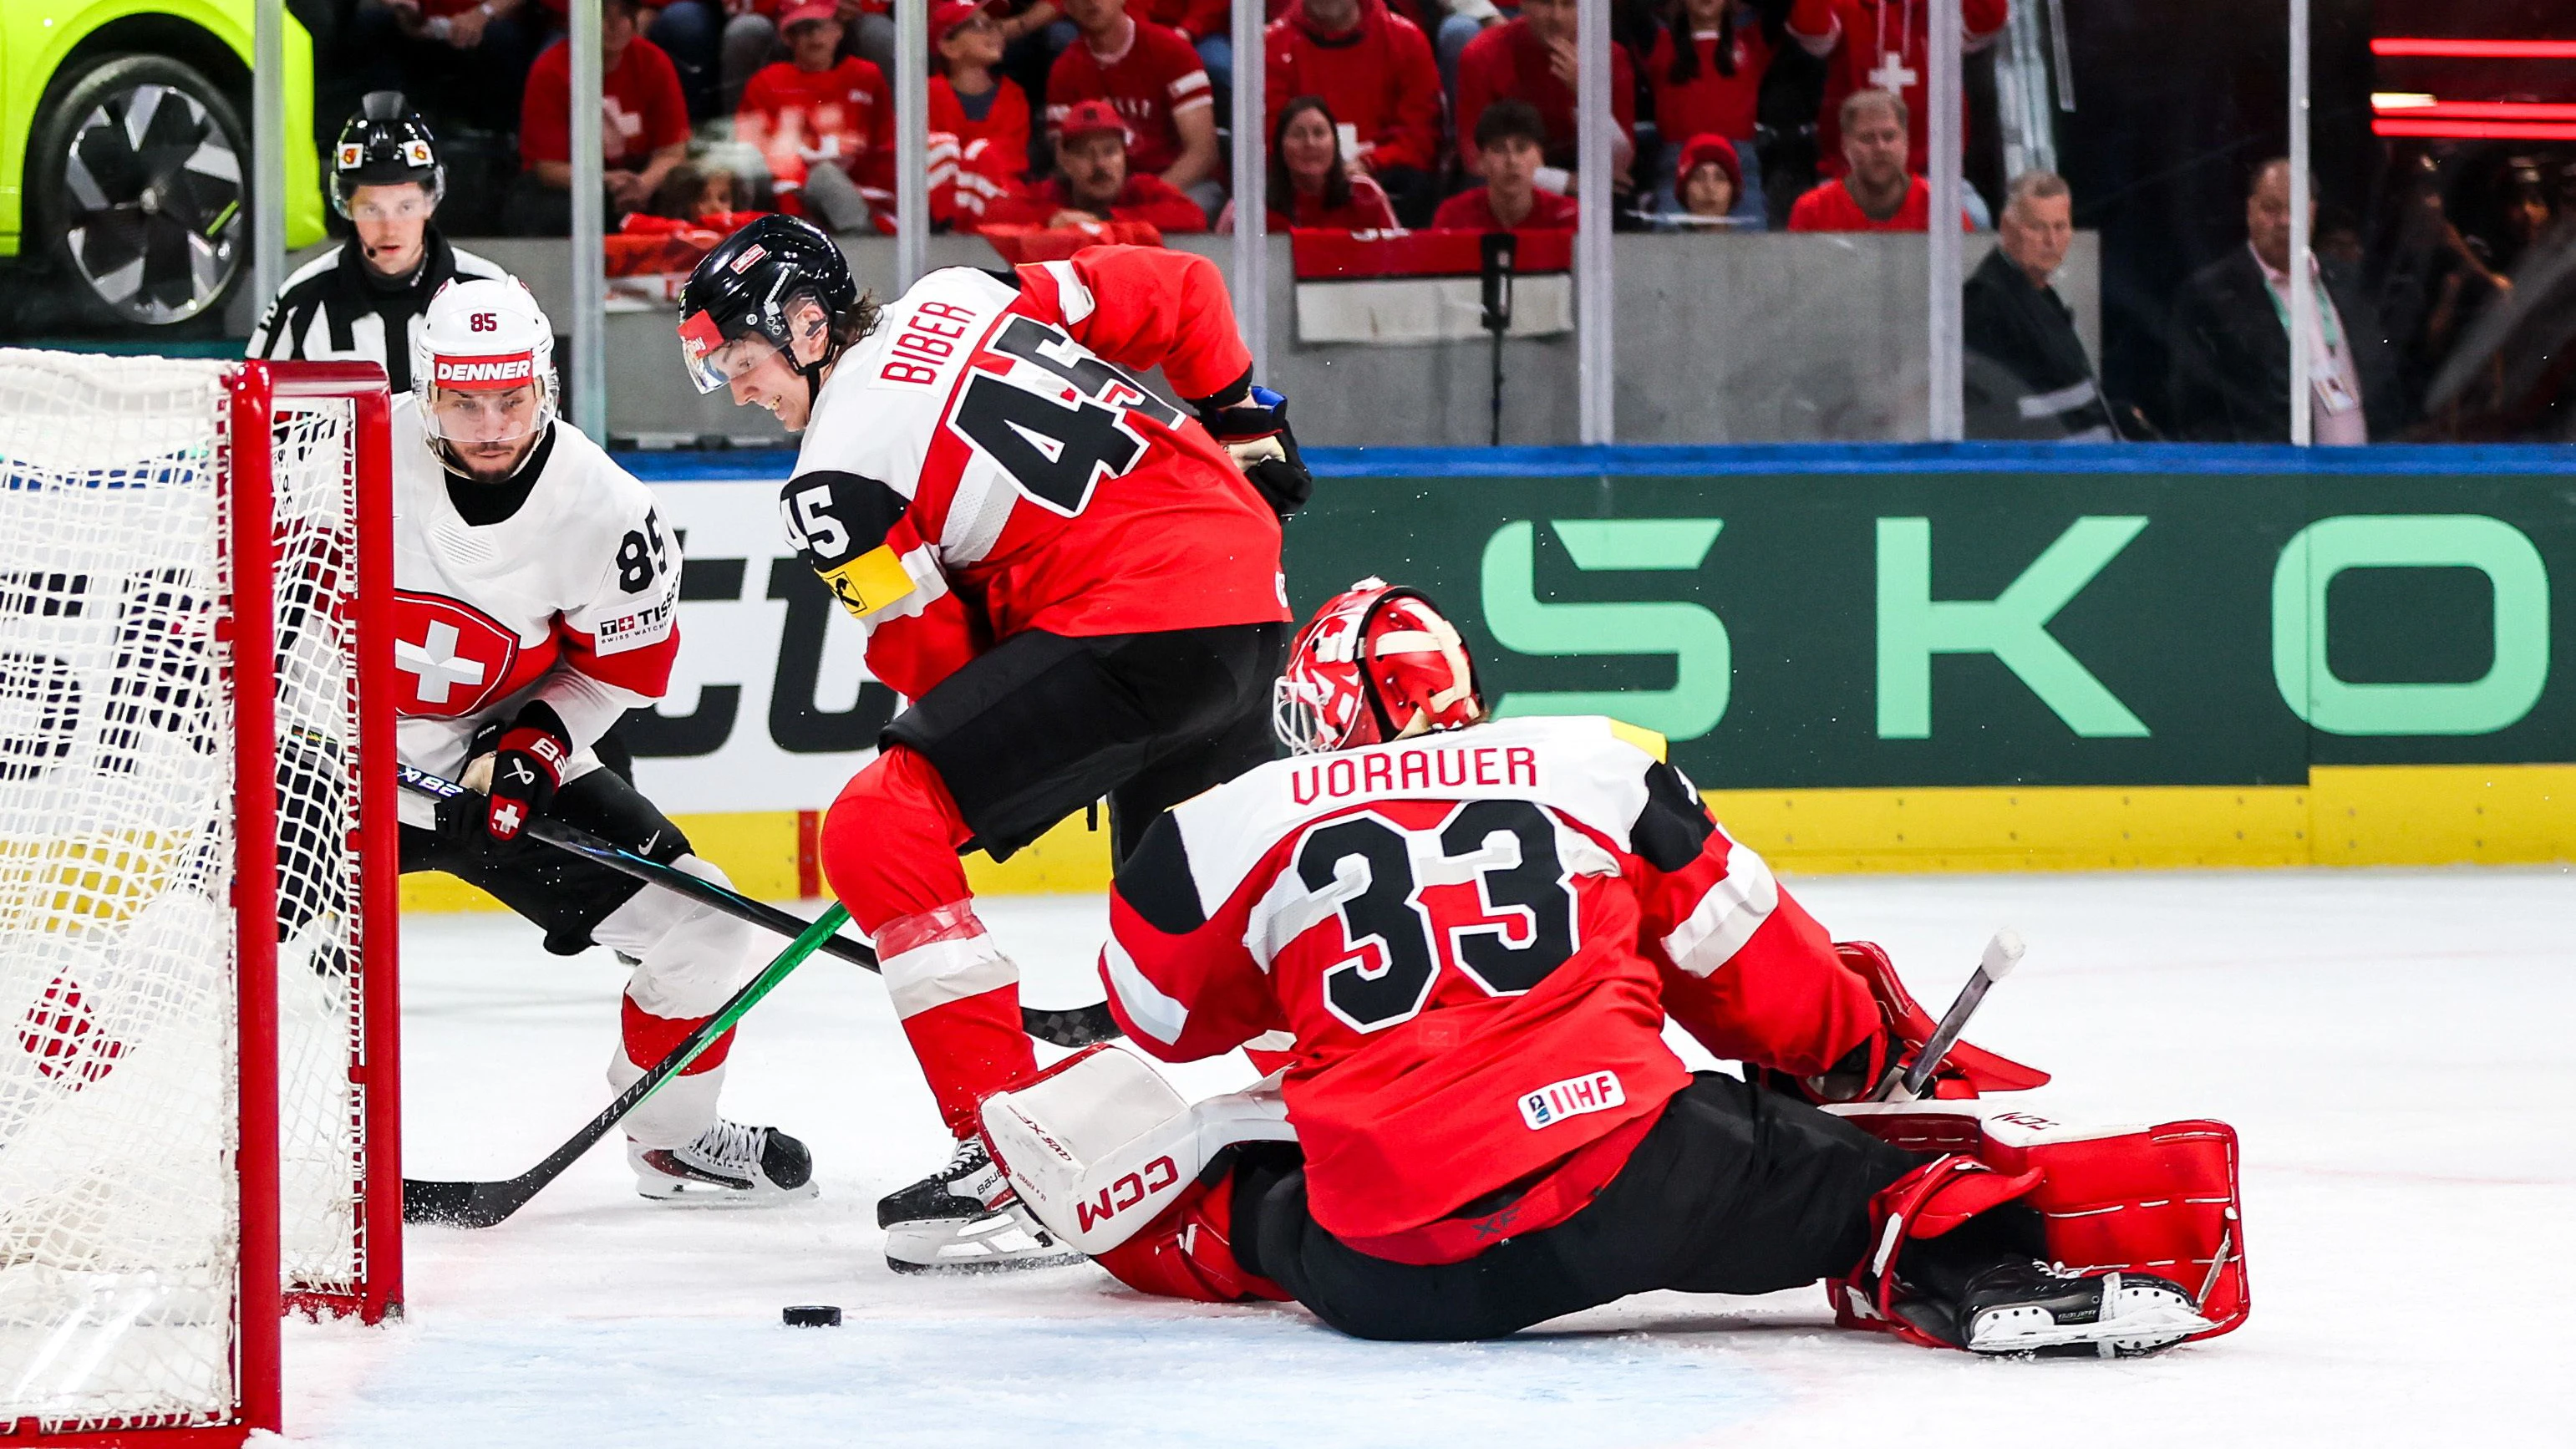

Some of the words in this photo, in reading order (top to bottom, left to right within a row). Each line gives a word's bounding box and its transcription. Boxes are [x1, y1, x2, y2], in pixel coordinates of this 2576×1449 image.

[470, 313, 497, 333] 85
[881, 302, 976, 385] BIBER
[437, 359, 531, 382] DENNER
[946, 312, 1187, 519] 45
[616, 502, 668, 595] 85
[1292, 746, 1537, 806] VORAUER
[1291, 799, 1581, 1035] 33
[601, 1055, 673, 1127] FLYLITE
[1550, 1075, 1613, 1115] IIHF
[1076, 1155, 1180, 1235] CCM
